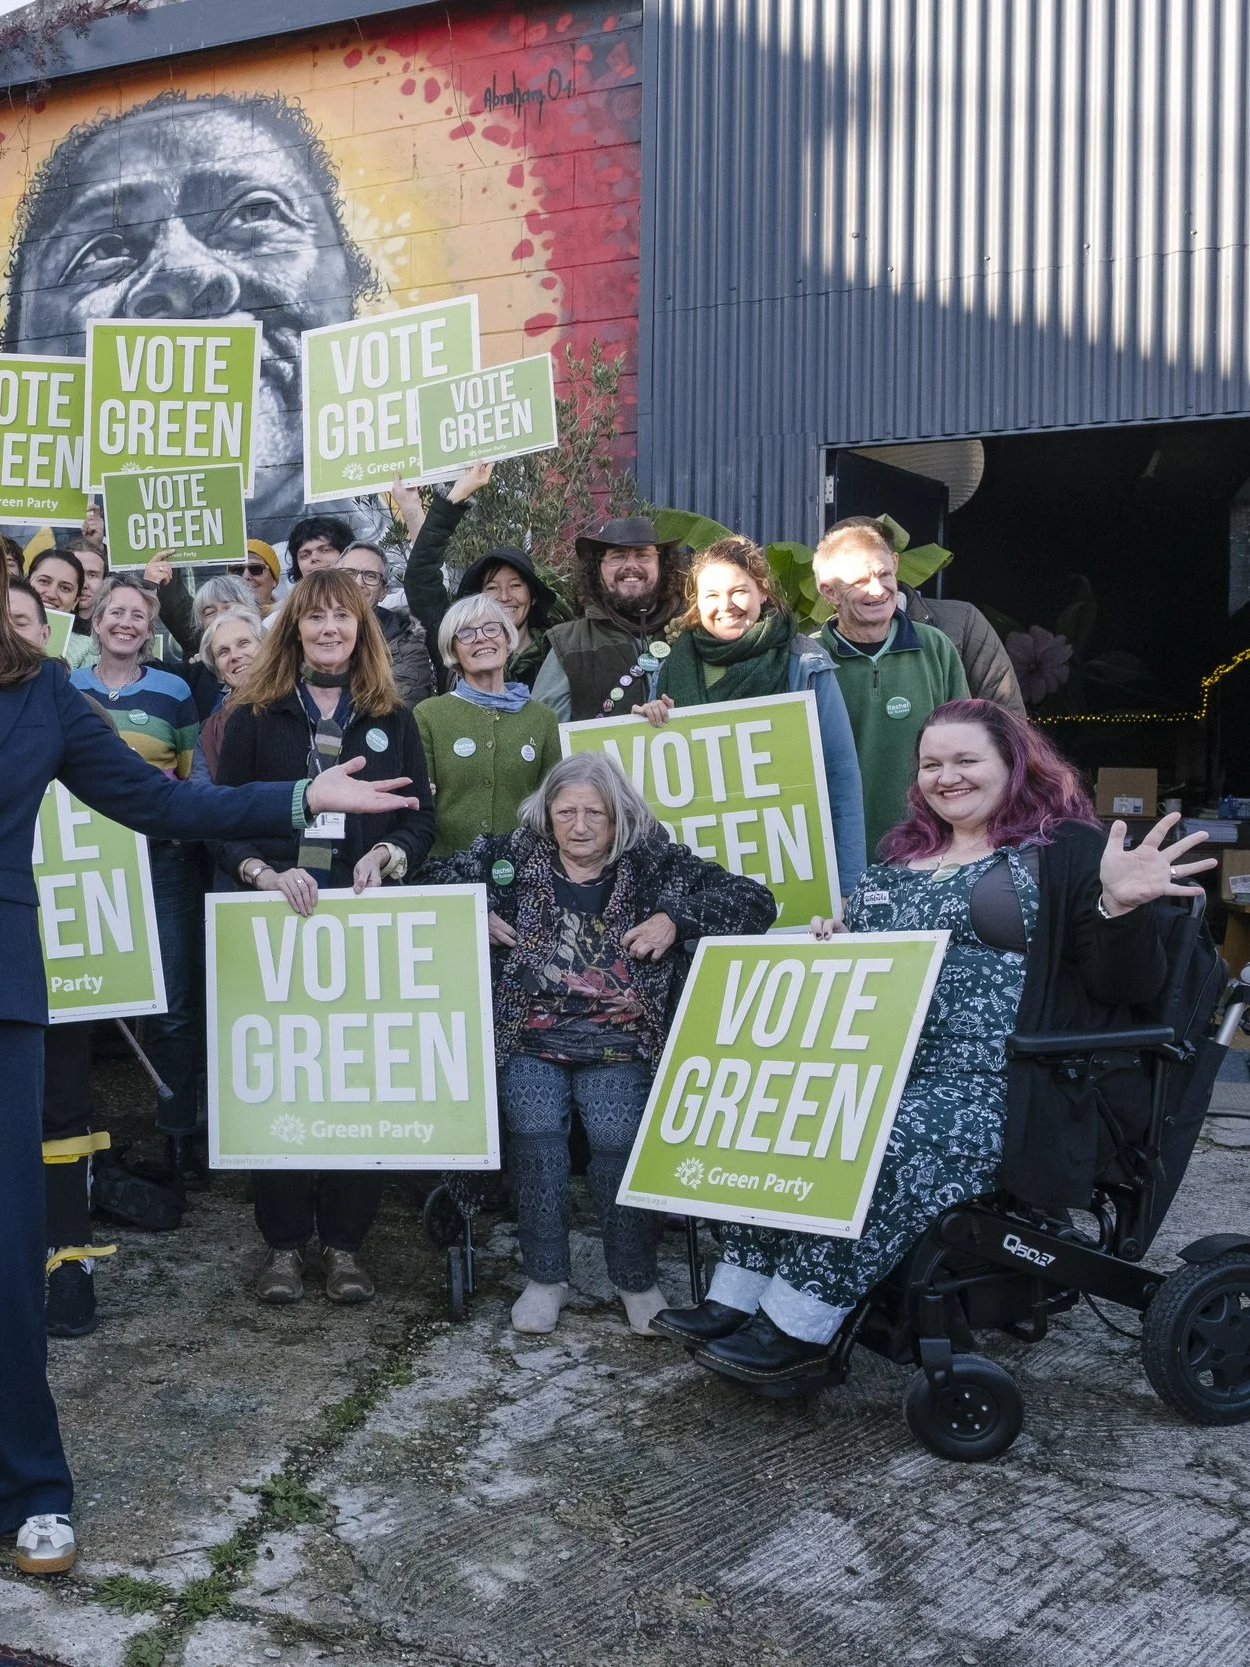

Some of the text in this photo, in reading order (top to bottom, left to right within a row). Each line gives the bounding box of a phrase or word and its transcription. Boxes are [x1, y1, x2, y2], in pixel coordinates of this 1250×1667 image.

[116, 335, 231, 394] VOTE
[330, 318, 448, 395] VOTE
[451, 368, 516, 413] VOTE
[99, 399, 243, 458] GREEN
[318, 389, 420, 461] GREE
[439, 399, 533, 453] GREEN
[367, 459, 405, 475] Green
[27, 497, 59, 512] Party
[138, 473, 206, 510] VOTE
[127, 508, 223, 550] GREEN
[183, 551, 197, 559] Party
[886, 702, 910, 710] Rachel
[603, 719, 780, 808] VOTE
[493, 866, 512, 874] Rachel
[251, 911, 440, 1002] VOTE
[50, 973, 103, 994] Party
[715, 958, 893, 1050] VOTE
[231, 1011, 469, 1104] GREEN
[659, 1055, 883, 1161] GREEN
[311, 1119, 435, 1143] Green Party
[219, 1158, 273, 1166] greenparty.org.uk
[708, 1167, 814, 1201] Green Party
